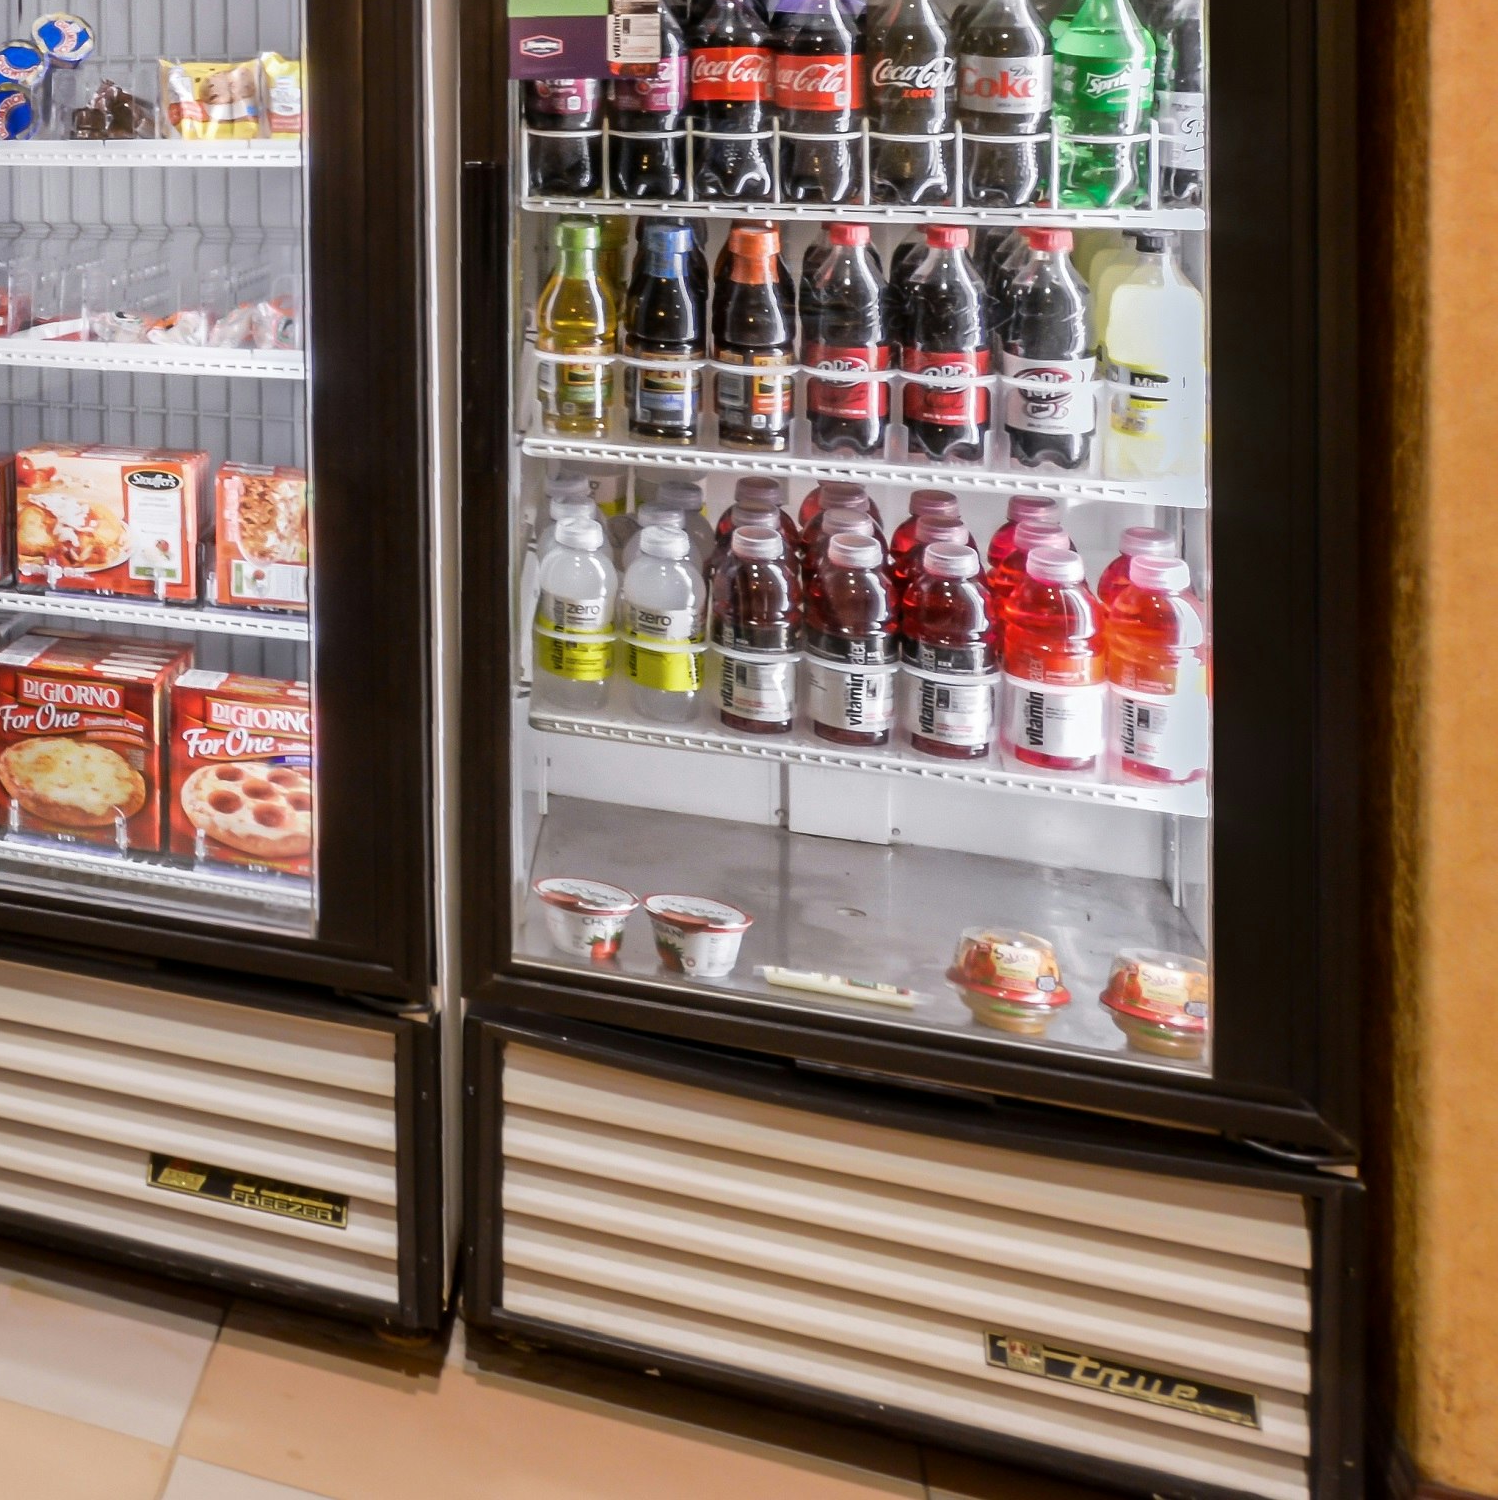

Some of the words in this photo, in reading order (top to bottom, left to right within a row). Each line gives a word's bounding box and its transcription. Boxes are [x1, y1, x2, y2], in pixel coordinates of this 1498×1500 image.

[902, 87, 935, 99] zero
[961, 65, 1038, 99] Coke
[131, 473, 178, 488] Stouffer's
[567, 603, 600, 615] zero
[638, 610, 672, 627] zero
[22, 677, 121, 709] DIGIORNO
[35, 702, 80, 729] One
[182, 728, 225, 758] For
[225, 726, 275, 757] One
[231, 1190, 333, 1221] FREEZER
